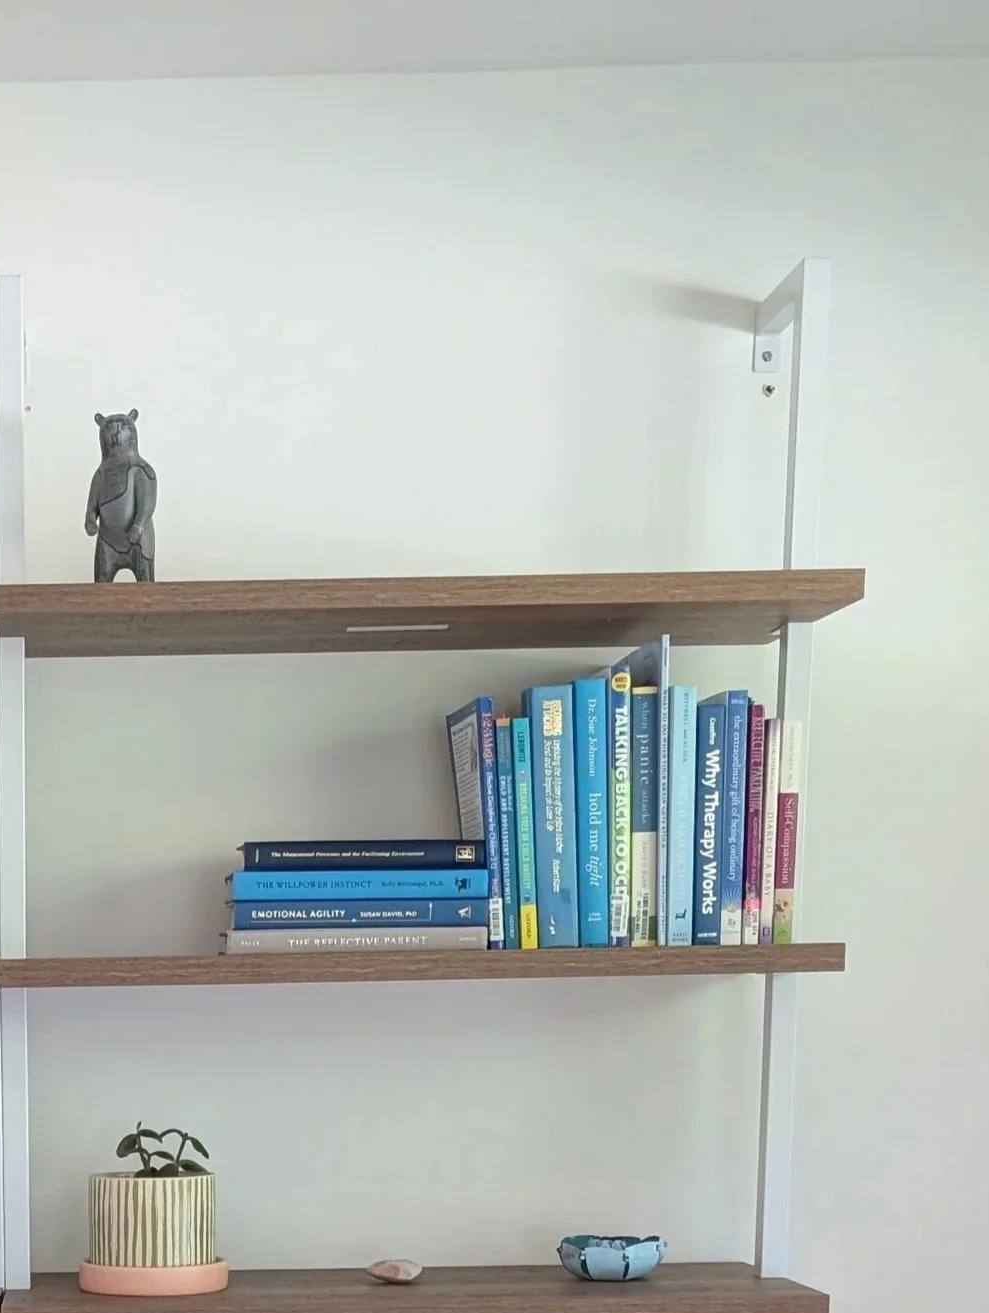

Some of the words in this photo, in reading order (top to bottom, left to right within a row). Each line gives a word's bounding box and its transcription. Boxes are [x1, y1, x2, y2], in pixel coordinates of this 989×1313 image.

[588, 698, 597, 714] Dr.
[641, 701, 650, 729] when
[588, 716, 597, 734] Sue
[733, 715, 742, 729] the
[588, 736, 598, 777] Johnson
[615, 705, 629, 780] TALKING
[636, 734, 653, 785] panic
[702, 748, 720, 788] Why
[730, 731, 742, 790] extraordinary
[588, 793, 602, 824] hold
[614, 783, 628, 830] BACK
[641, 790, 651, 824] attacks
[730, 791, 741, 806] gift
[732, 808, 740, 816] of
[700, 790, 720, 858] Therapy
[728, 819, 740, 844] being
[589, 830, 599, 852] me
[615, 835, 628, 857] TO
[781, 798, 795, 884] Self-Compassion
[585, 855, 603, 886] tight
[615, 860, 628, 896] OCD
[726, 845, 739, 882] ordinary
[256, 881, 274, 889] THE
[276, 881, 328, 889] WILLPOWER
[330, 880, 372, 888] INSTINCT
[702, 861, 717, 915] Works
[251, 910, 307, 919] EMOTIONAL
[309, 910, 346, 918] AGILITY
